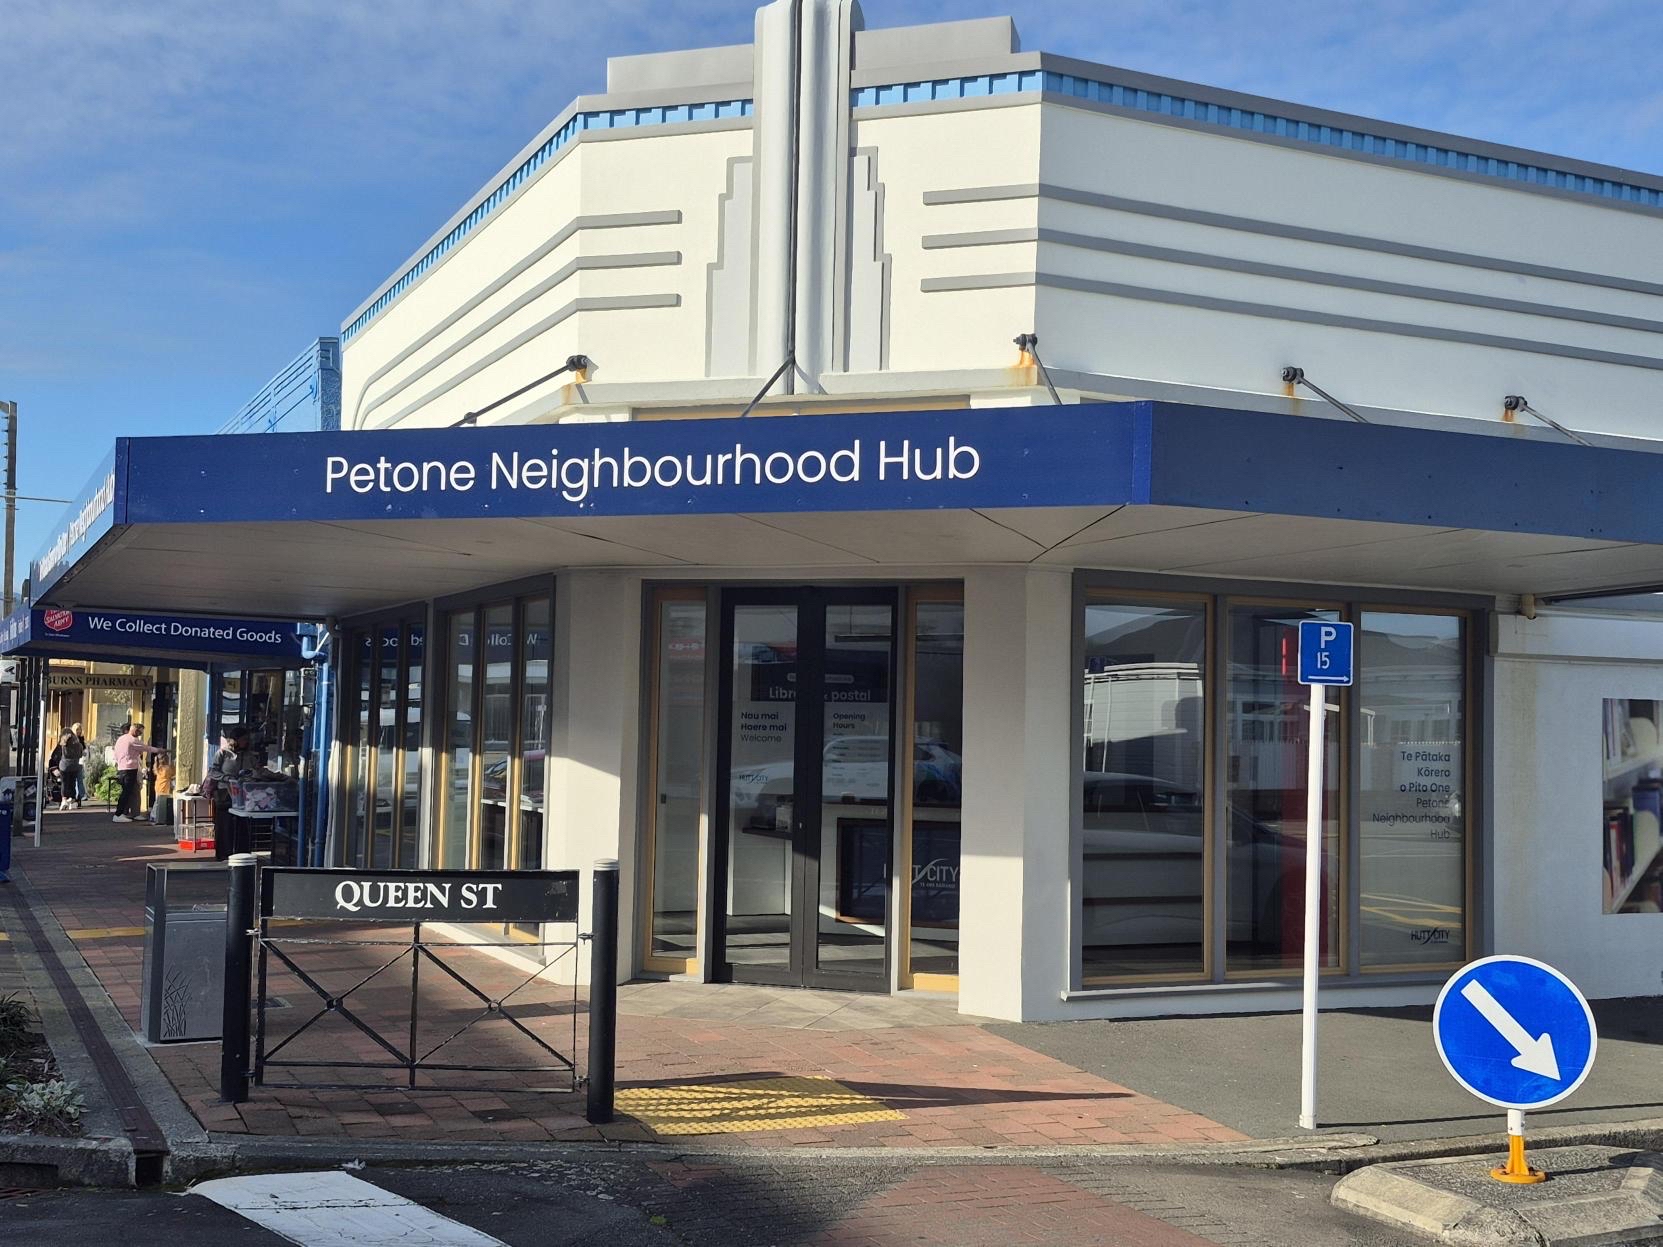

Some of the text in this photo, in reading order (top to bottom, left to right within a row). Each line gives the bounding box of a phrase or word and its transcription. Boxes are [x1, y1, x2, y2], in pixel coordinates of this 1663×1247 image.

[325, 435, 981, 504] Petone Neighbourhood Hub
[54, 615, 69, 628] ARMY
[88, 616, 282, 644] We Collect Donated Goods
[1319, 626, 1337, 649] P
[1316, 651, 1330, 669] 15
[85, 677, 150, 688] PHARMACY
[831, 690, 871, 702] postal
[832, 712, 866, 722] Opening
[832, 722, 855, 730] Hours
[741, 733, 782, 743] Welcome
[1401, 750, 1451, 762] Te Pātaka
[1417, 766, 1451, 778] Kōrero
[1409, 781, 1428, 793] Pito
[1430, 782, 1451, 793] One
[1430, 829, 1451, 840] Hub
[927, 865, 959, 882] CITY
[334, 881, 503, 912] QUEEN ST
